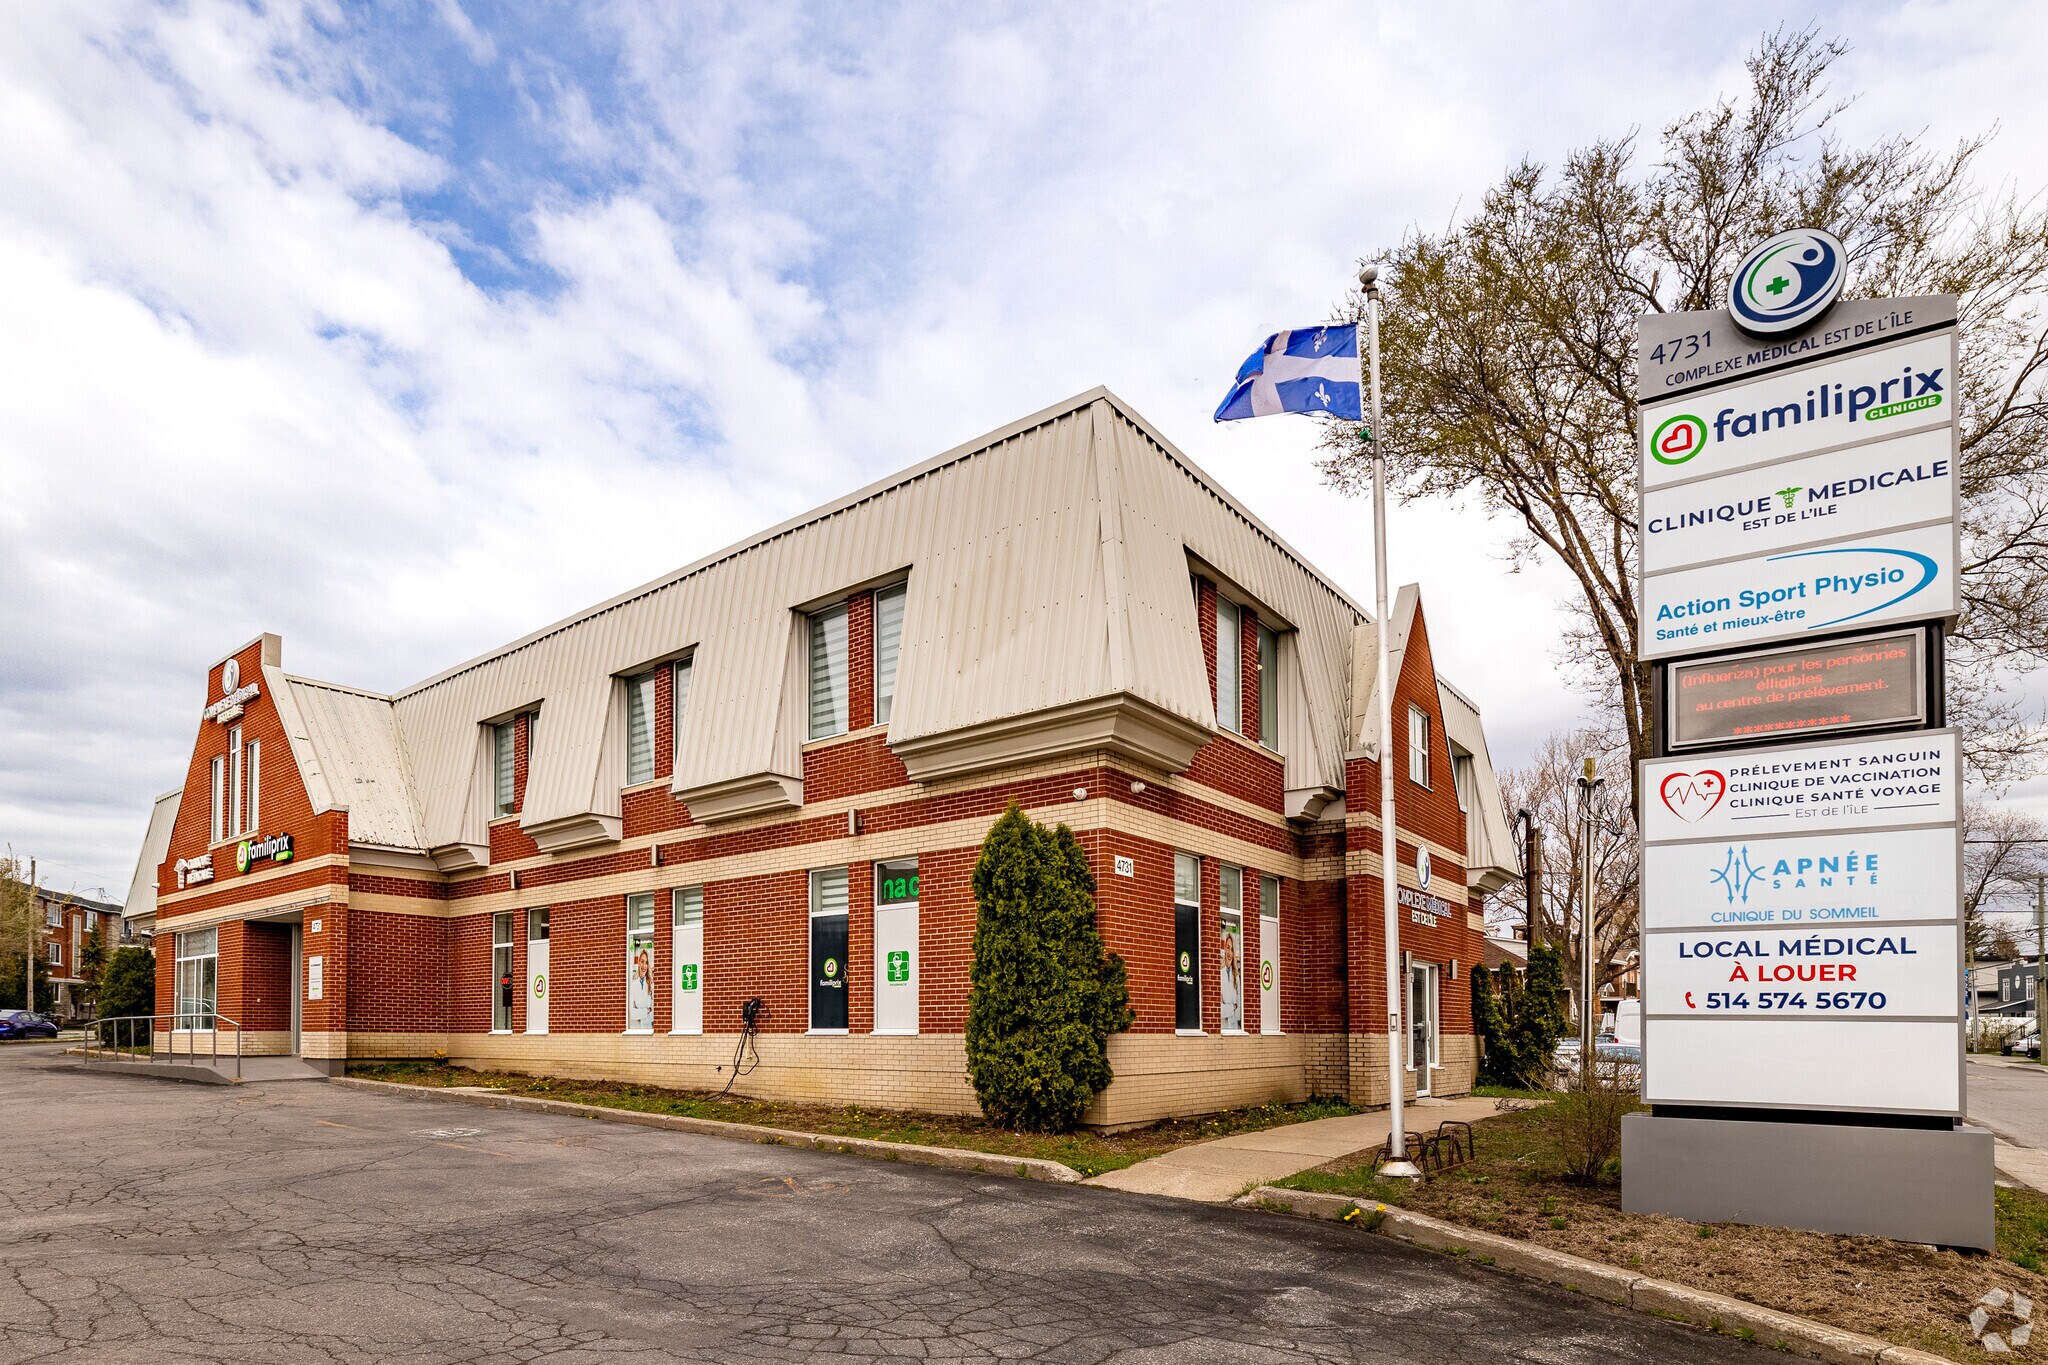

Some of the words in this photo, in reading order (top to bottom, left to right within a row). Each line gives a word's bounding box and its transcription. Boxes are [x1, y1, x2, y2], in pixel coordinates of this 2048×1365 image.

[1650, 330, 1712, 366] 4731
[1665, 357, 1743, 386] COMPLEXE
[1746, 337, 1820, 367] MÉDICAL
[1824, 327, 1851, 345] EST
[1855, 321, 1874, 337] DE
[1713, 366, 1944, 443] familiprix
[1869, 396, 1937, 420] CLINIQUE
[1648, 496, 1772, 534] CLINIQUE
[1808, 460, 1949, 503] MEDICALE
[1743, 517, 1770, 531] EST
[1775, 512, 1796, 525] DE
[1656, 594, 1731, 622] Action
[1739, 582, 1807, 610] Sport
[1815, 567, 1905, 596] Physio
[1656, 623, 1699, 641] Santé
[1703, 618, 1718, 633] et
[1722, 608, 1806, 631] mieux-être
[1763, 662, 1797, 677] pour
[1802, 658, 1822, 671] les
[1695, 702, 1713, 712] au
[1717, 694, 1762, 709] centre
[1765, 691, 1784, 704] de
[1730, 758, 1851, 777] PRÉLEVEMENT
[1859, 750, 1941, 766] SANGUIN
[1729, 778, 1799, 793] CLINIQUE
[1805, 776, 1825, 786] DE
[1830, 766, 1941, 784] VACCINATION
[1729, 794, 1804, 809] CLINIQUE
[1811, 788, 1864, 802] SANTÉ
[1871, 783, 1941, 797] VOYAGE
[248, 832, 289, 860] familiprix
[1116, 860, 1133, 874] 4731
[1772, 850, 1879, 876] APNÉE
[1773, 873, 1878, 889] SANTÉ
[1395, 887, 1426, 912] OMPLEXE
[1711, 911, 1775, 923] CLINIQUE
[1782, 910, 1802, 920] DU
[1809, 907, 1879, 920] SOMMEIL
[1679, 940, 1770, 958] LOCAL
[1779, 935, 1917, 956] MÉDICAL
[1729, 961, 1749, 982] À
[1758, 964, 1857, 982] LOUER
[1706, 992, 1750, 1009] 514
[1757, 992, 1807, 1009] 574
[1815, 992, 1887, 1009] 5670
